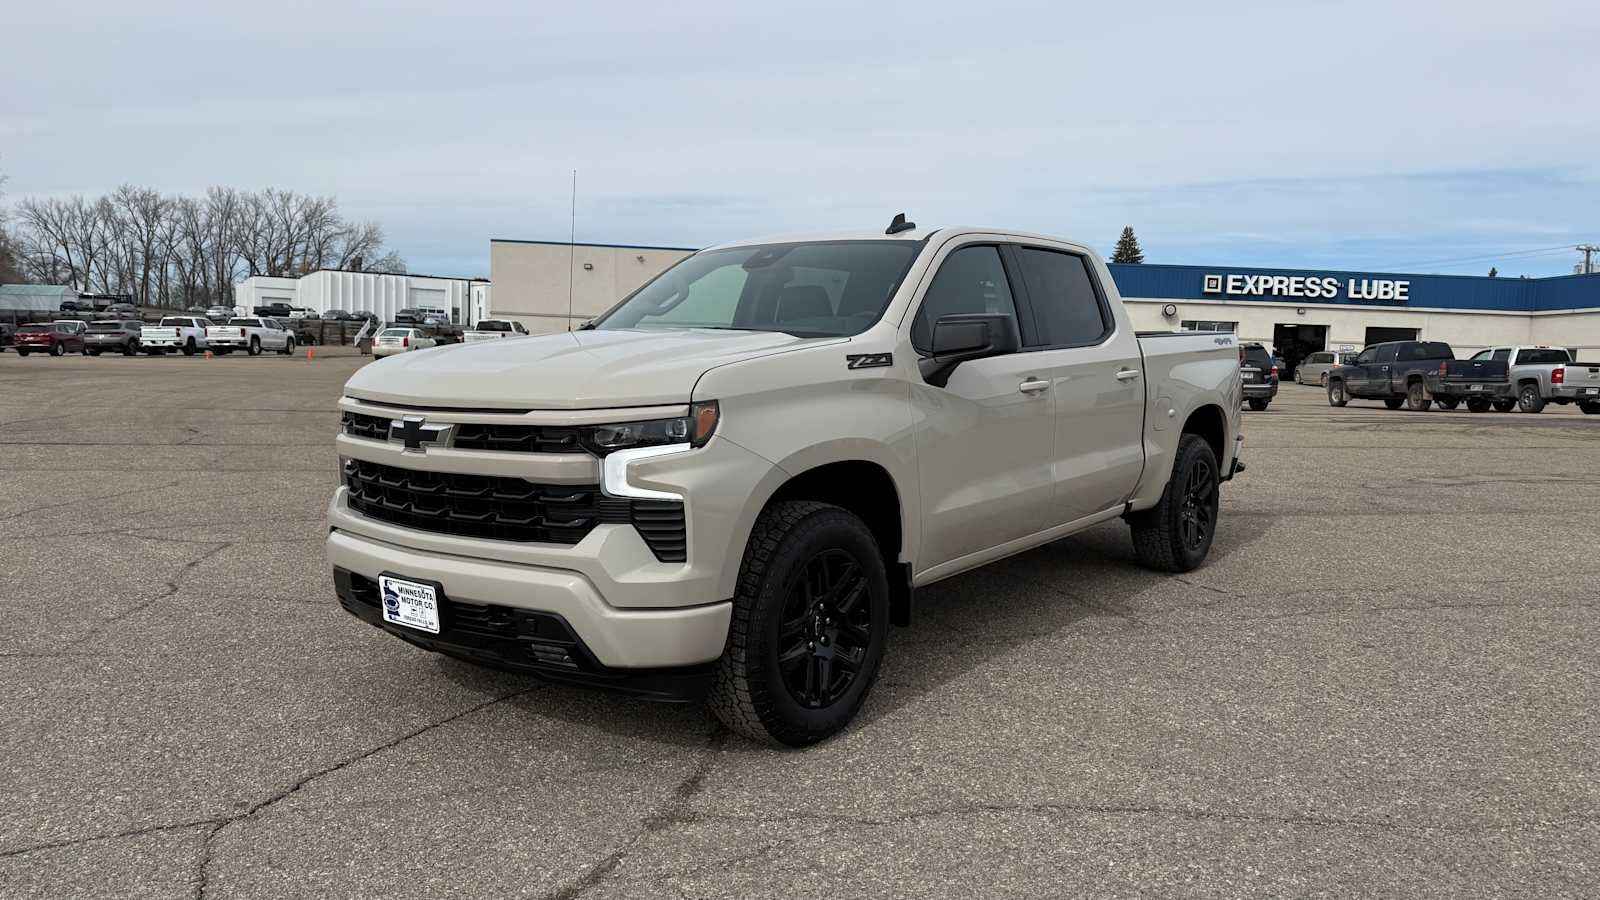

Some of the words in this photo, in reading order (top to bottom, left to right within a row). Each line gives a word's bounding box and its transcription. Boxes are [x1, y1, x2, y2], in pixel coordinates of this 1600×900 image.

[1226, 274, 1338, 298] EXPRESS
[1348, 279, 1410, 300] LUBE
[398, 586, 433, 601] MINNESOTA
[401, 596, 423, 607] MOTOR
